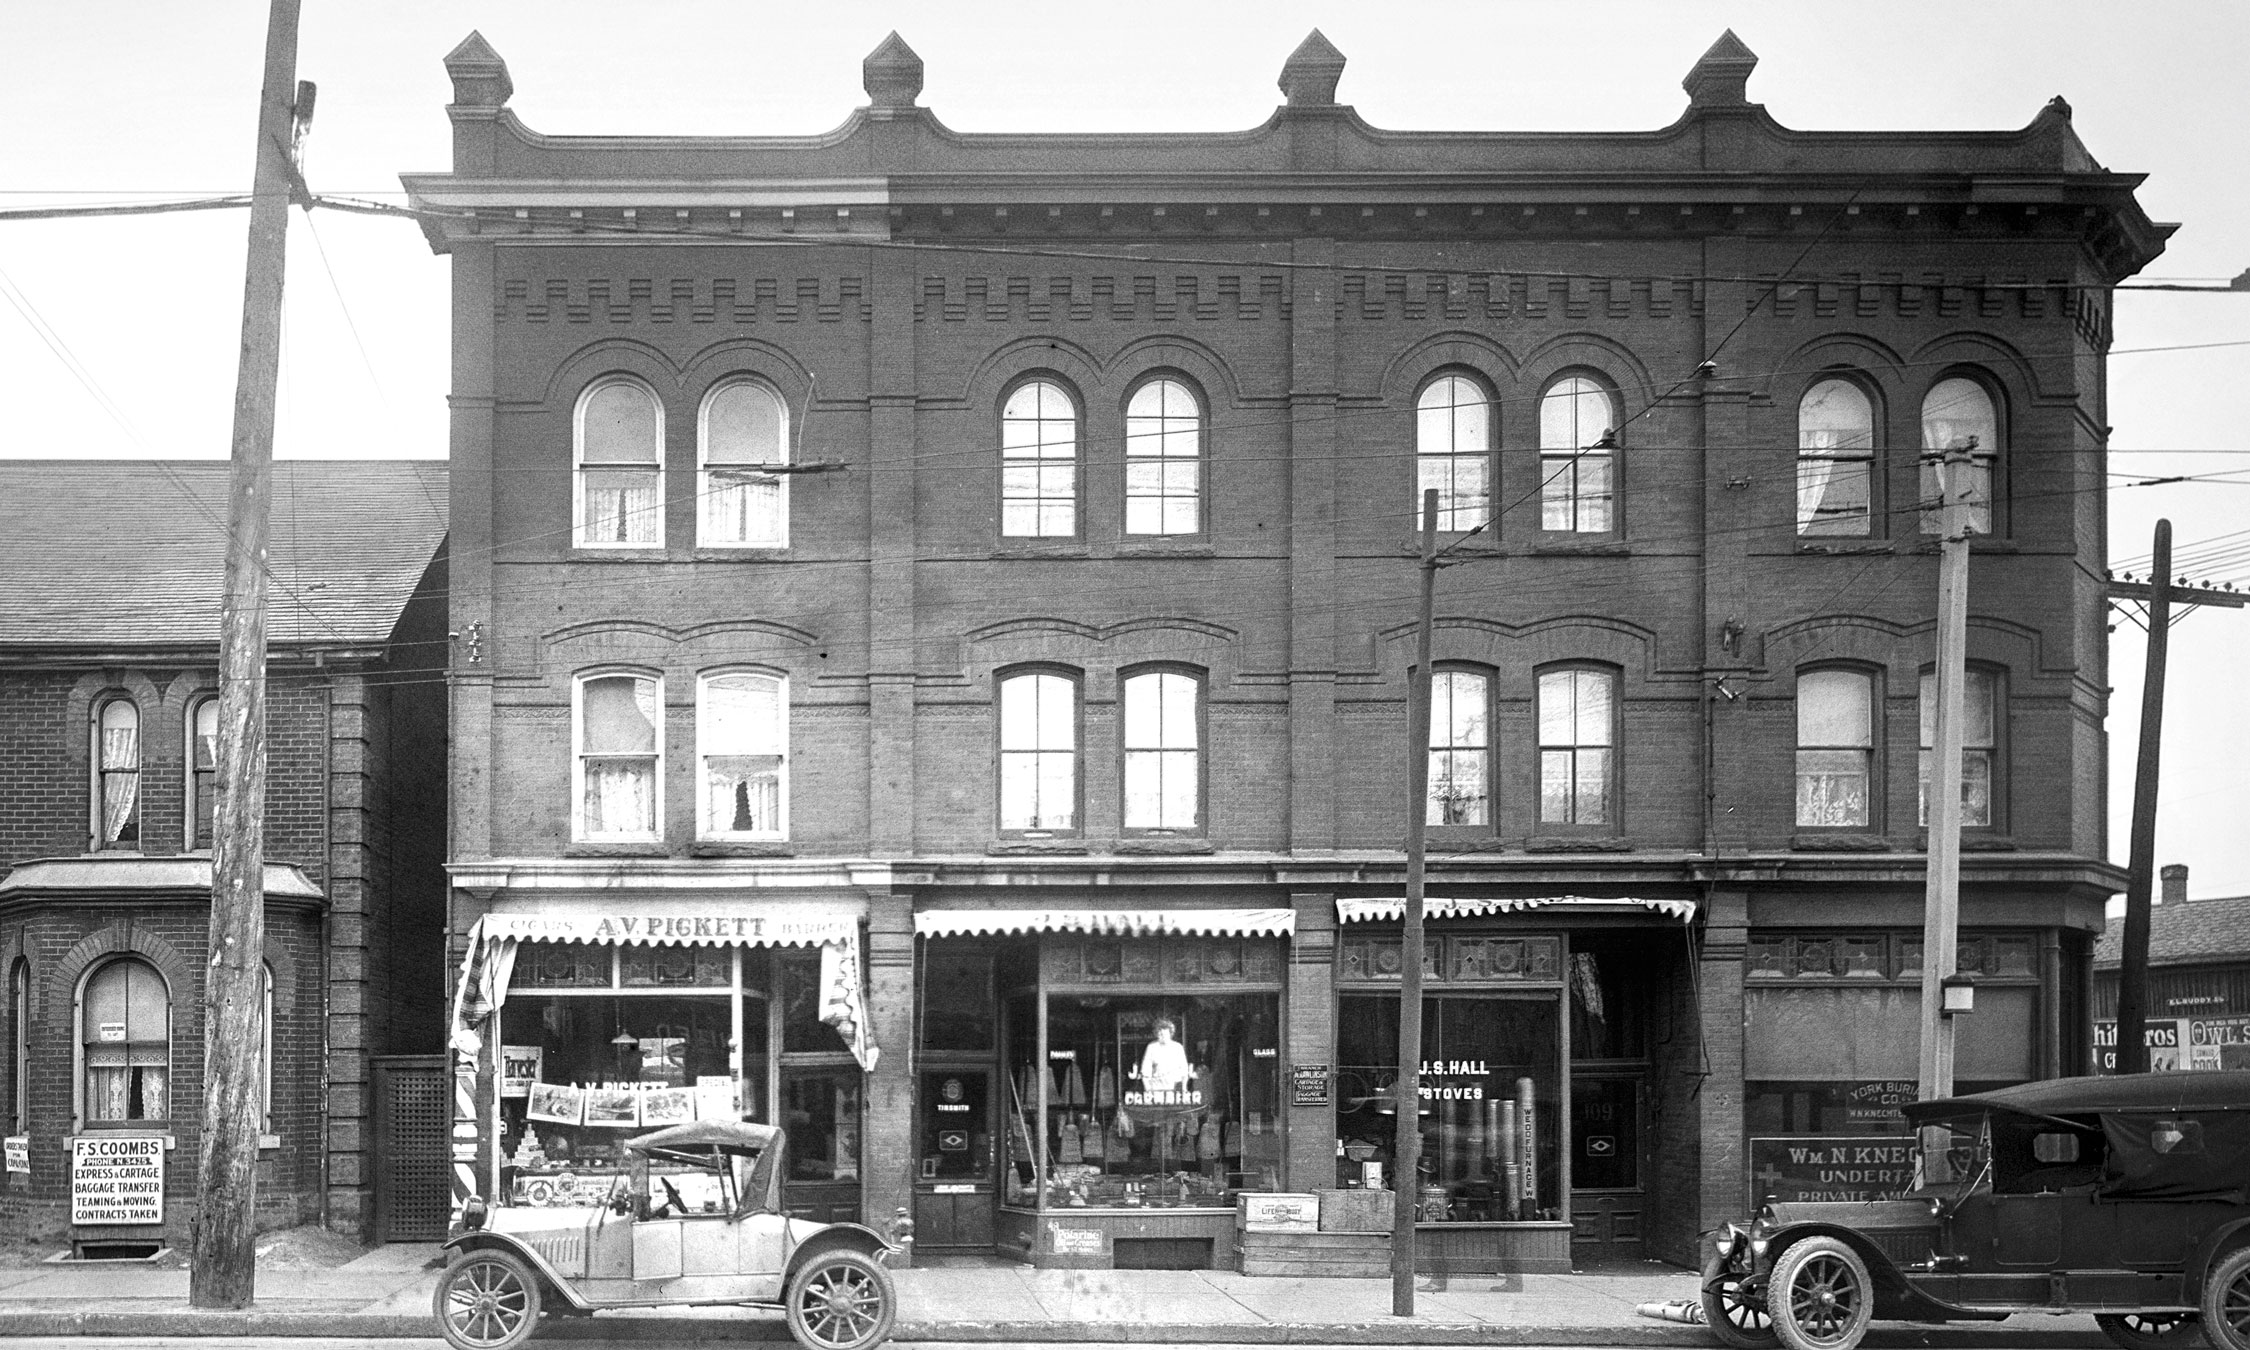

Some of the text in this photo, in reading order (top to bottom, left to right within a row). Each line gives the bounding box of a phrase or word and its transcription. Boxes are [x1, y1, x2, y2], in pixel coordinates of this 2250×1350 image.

[647, 917, 766, 937] PICKETT
[2144, 1028, 2176, 1047] ros
[2191, 1020, 2237, 1046] OWL
[1423, 1087, 1483, 1100] STOVES
[1850, 1082, 1884, 1099] YORK
[86, 1157, 114, 1166] PHONE
[75, 1167, 159, 1179] EXPRESS & CARTAGE
[1819, 1170, 1918, 1184] UNDERTA
[75, 1182, 160, 1194] BAGGAGE TRANSFER
[1798, 1190, 1869, 1201] PRIVATE
[76, 1197, 116, 1207] TEAMING
[75, 1209, 158, 1220] CONTRACTS TAKEN
